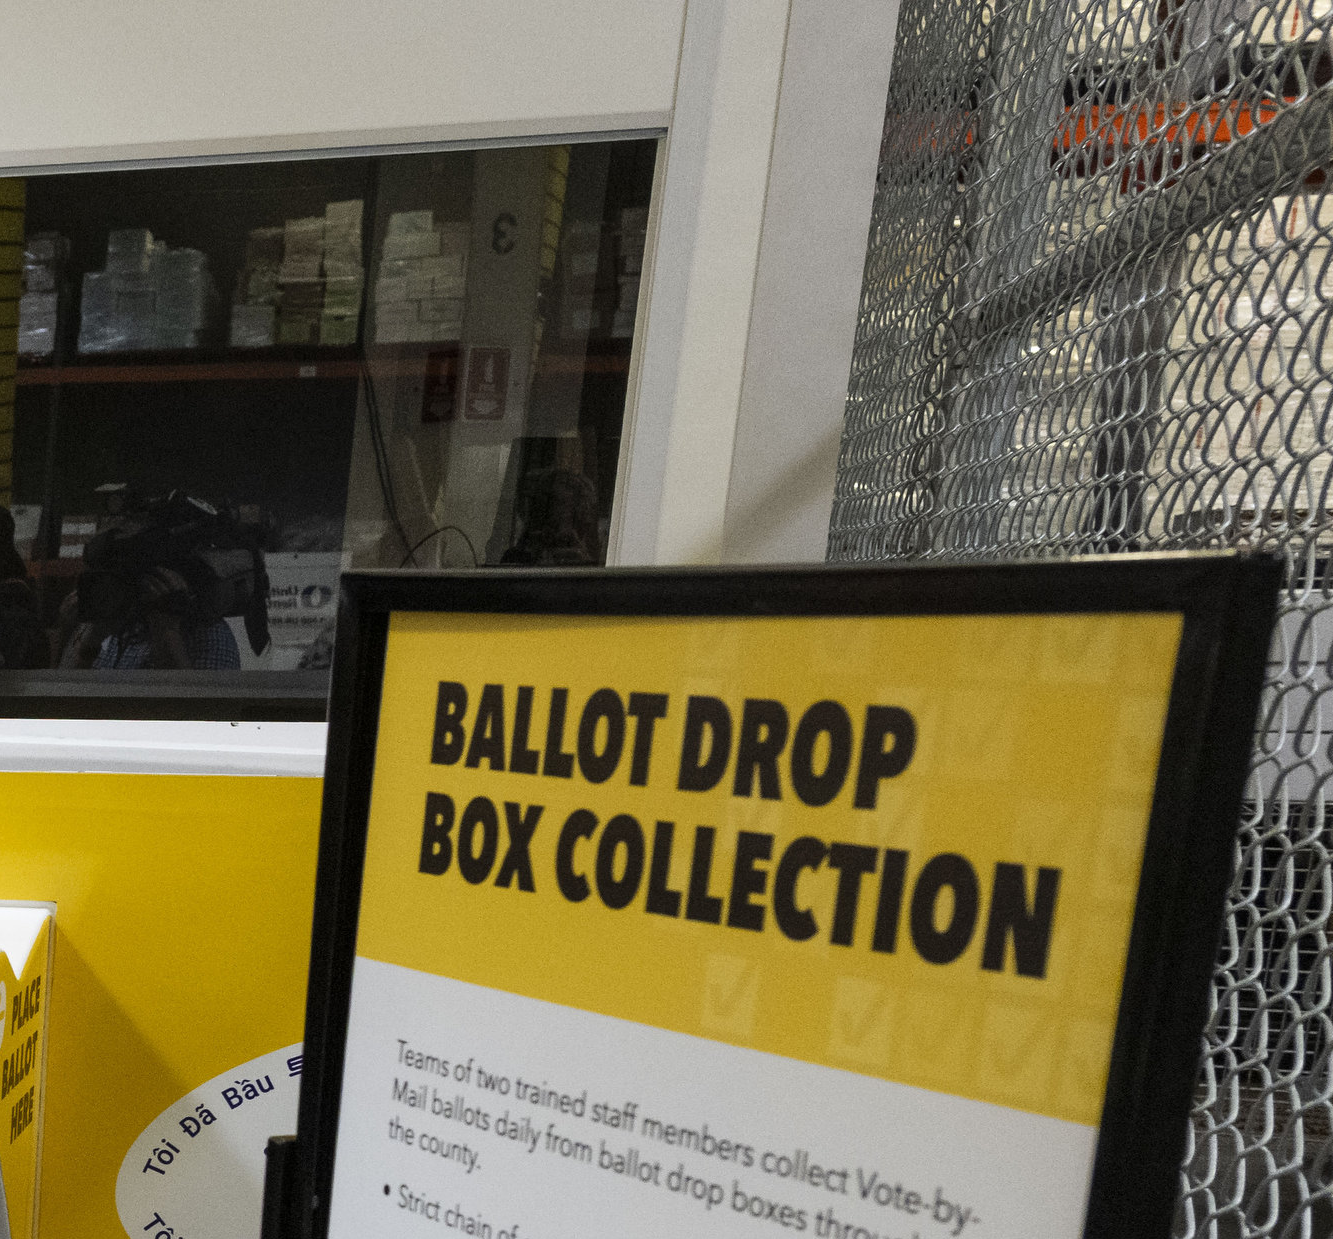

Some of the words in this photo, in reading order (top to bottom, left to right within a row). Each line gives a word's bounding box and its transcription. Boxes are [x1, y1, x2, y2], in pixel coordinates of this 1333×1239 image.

[430, 680, 669, 786] BALLOT
[677, 694, 917, 809] DROP
[418, 791, 545, 893] BOX
[556, 808, 1063, 980] COLLECTION
[11, 975, 41, 1036] PLACE
[1, 1030, 38, 1099] BALLOT
[9, 1085, 34, 1145] HERE
[143, 1138, 181, 1176] Tôi
[178, 1103, 217, 1138] Đã
[221, 1075, 275, 1110] Bầu
[389, 1116, 414, 1145] the
[419, 1132, 481, 1174] county.
[392, 1077, 427, 1110] Mail
[432, 1089, 490, 1131] ballots
[495, 1110, 541, 1153] daily
[545, 1124, 593, 1163] from
[599, 1139, 661, 1186] ballot
[666, 1163, 724, 1211] drop
[731, 1178, 806, 1231] boxes
[398, 1039, 449, 1078] Teams
[454, 1058, 474, 1083] of
[476, 1066, 510, 1095] two
[516, 1078, 587, 1118] trained
[592, 1100, 638, 1132] staff
[641, 1116, 754, 1167] members
[761, 1149, 848, 1194] collect
[857, 1167, 980, 1237] Vote-by-
[398, 1184, 440, 1223] Strict
